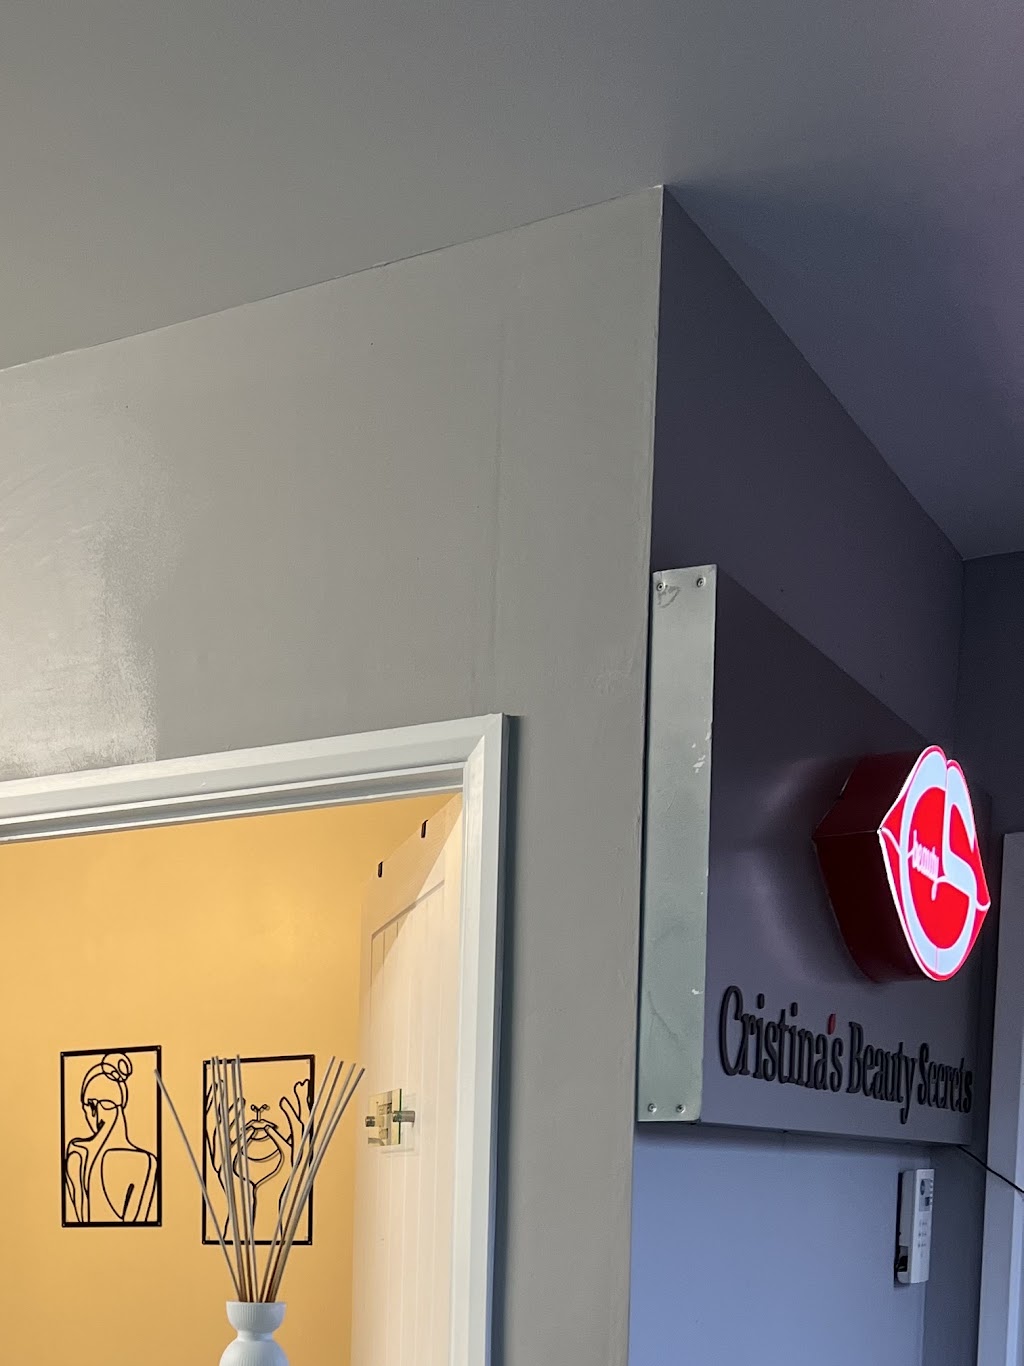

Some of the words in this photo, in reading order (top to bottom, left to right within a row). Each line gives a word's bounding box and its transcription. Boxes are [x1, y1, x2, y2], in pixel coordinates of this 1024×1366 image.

[718, 985, 844, 1093] Cristina's
[846, 1021, 918, 1125] Beauty
[917, 1042, 973, 1114] Secrets
